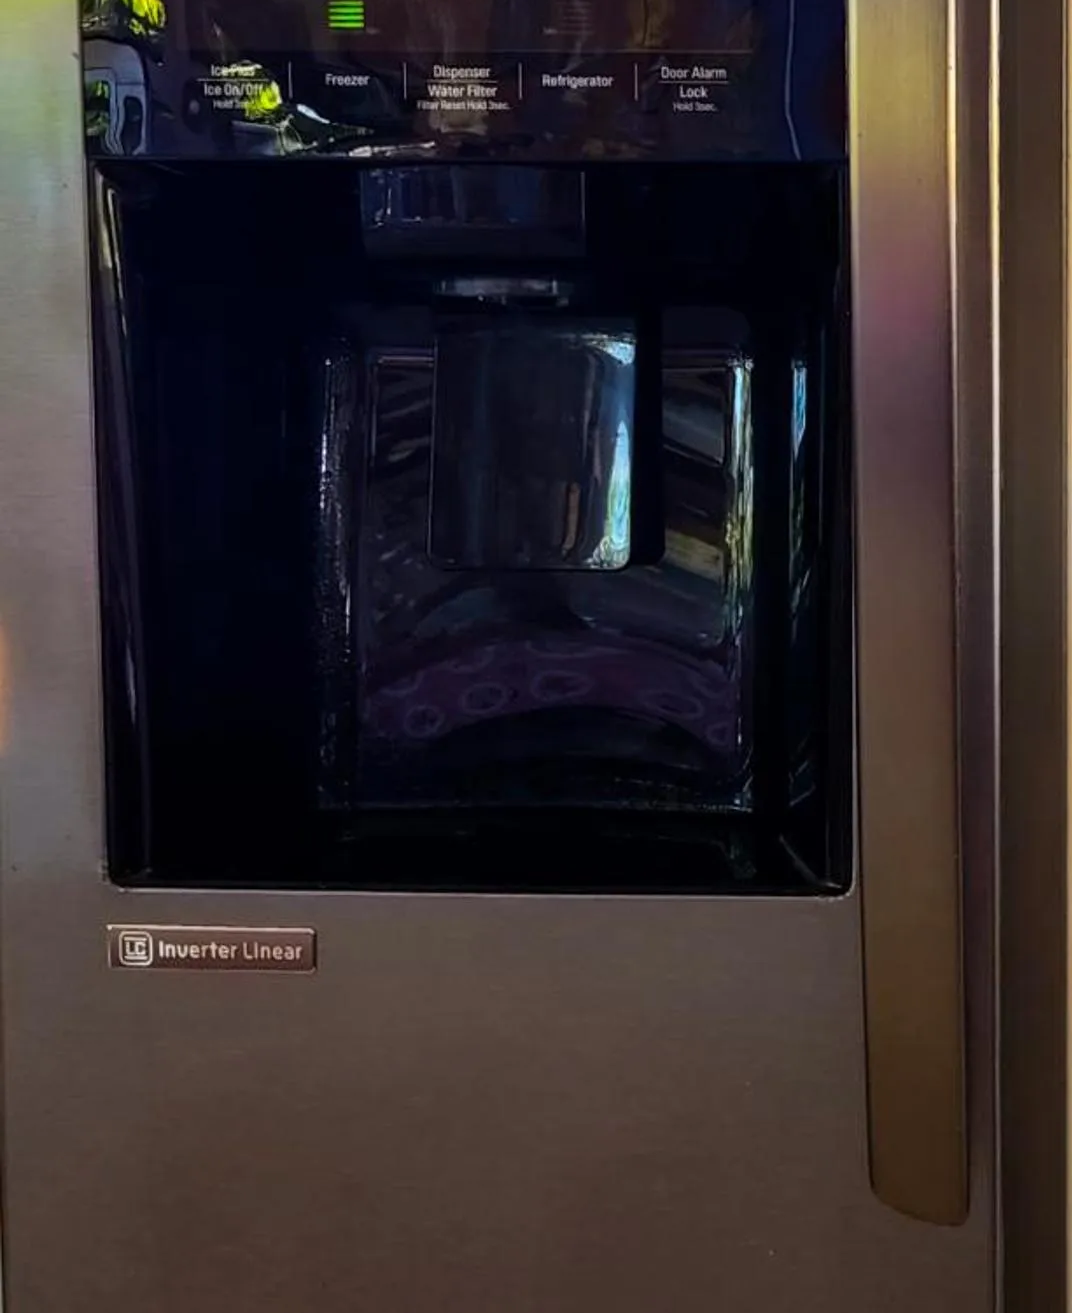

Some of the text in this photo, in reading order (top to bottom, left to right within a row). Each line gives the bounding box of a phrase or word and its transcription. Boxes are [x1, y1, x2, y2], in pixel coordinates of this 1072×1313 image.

[433, 65, 491, 79] Dispenser
[661, 66, 727, 79] Door Alarm
[325, 73, 370, 86] Freezer
[542, 74, 614, 88] Refrigerator
[428, 85, 498, 98] Water Filter
[680, 86, 708, 99] Lock
[159, 940, 237, 959] Inverter
[243, 942, 302, 960] Linear
